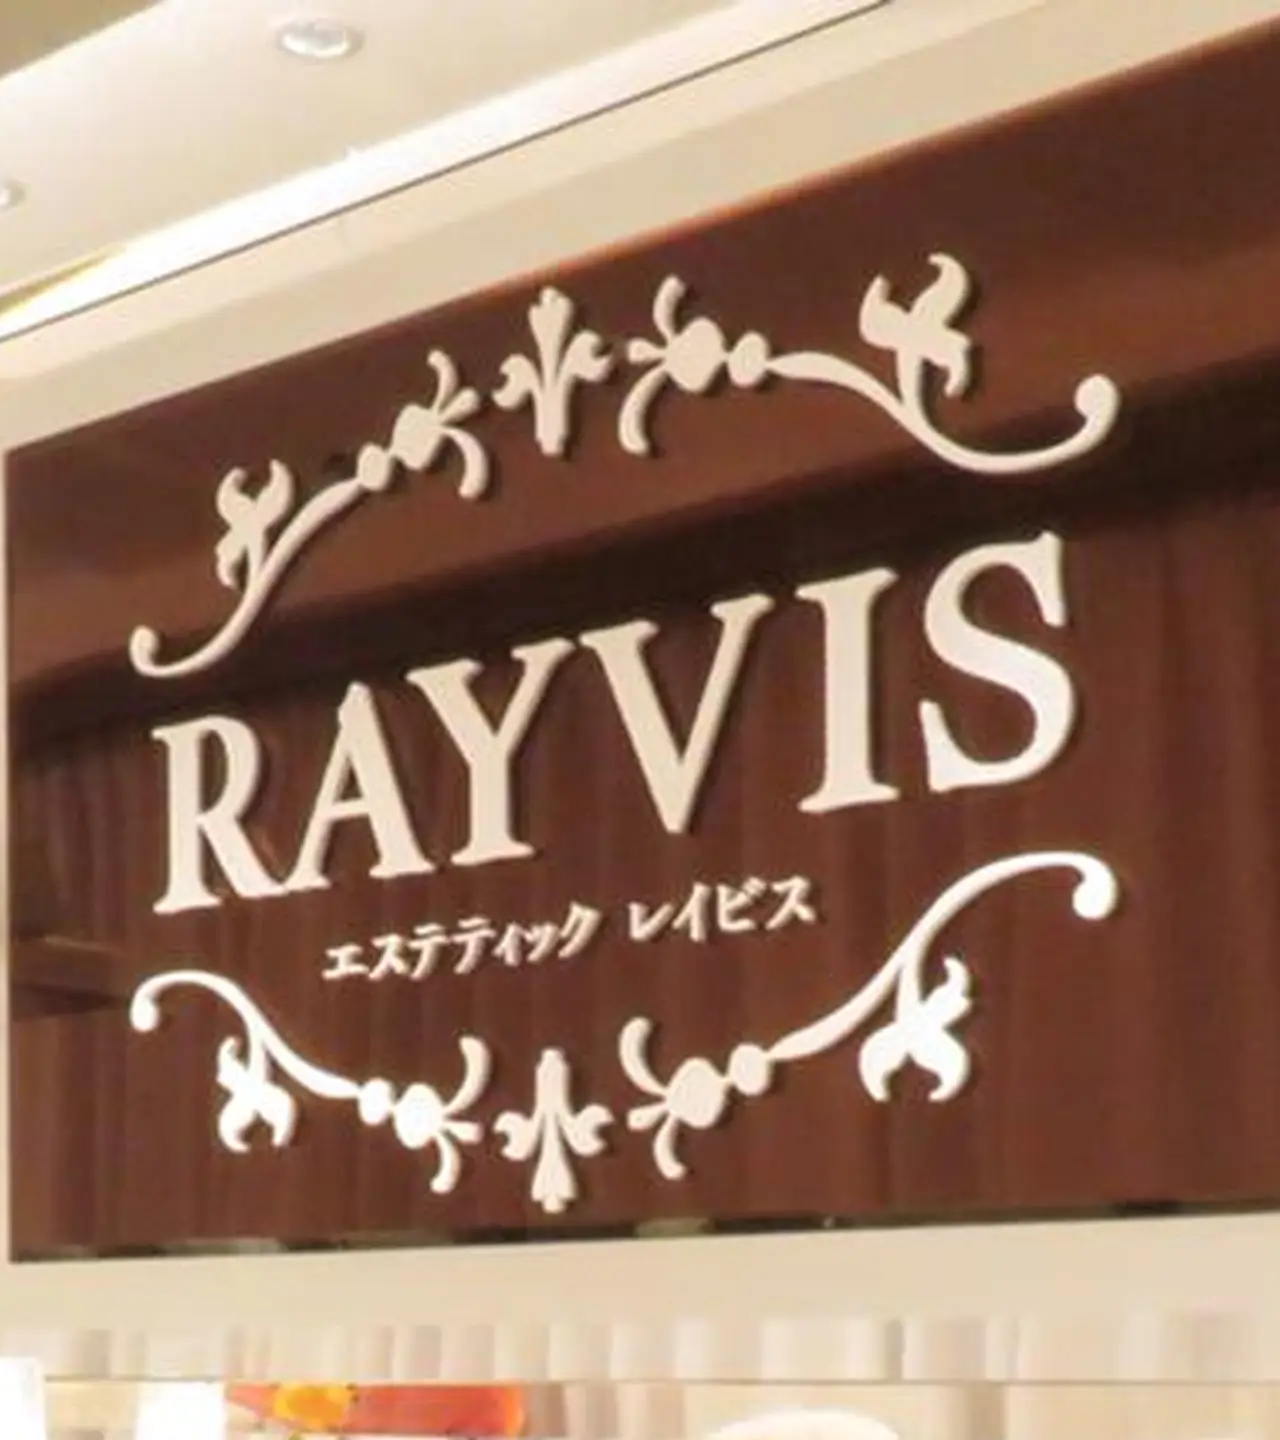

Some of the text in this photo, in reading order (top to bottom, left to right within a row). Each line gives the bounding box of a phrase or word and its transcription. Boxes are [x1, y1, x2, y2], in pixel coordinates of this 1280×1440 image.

[153, 533, 1076, 913] RAYVIS
[322, 876, 818, 979] エステティック レイビス
